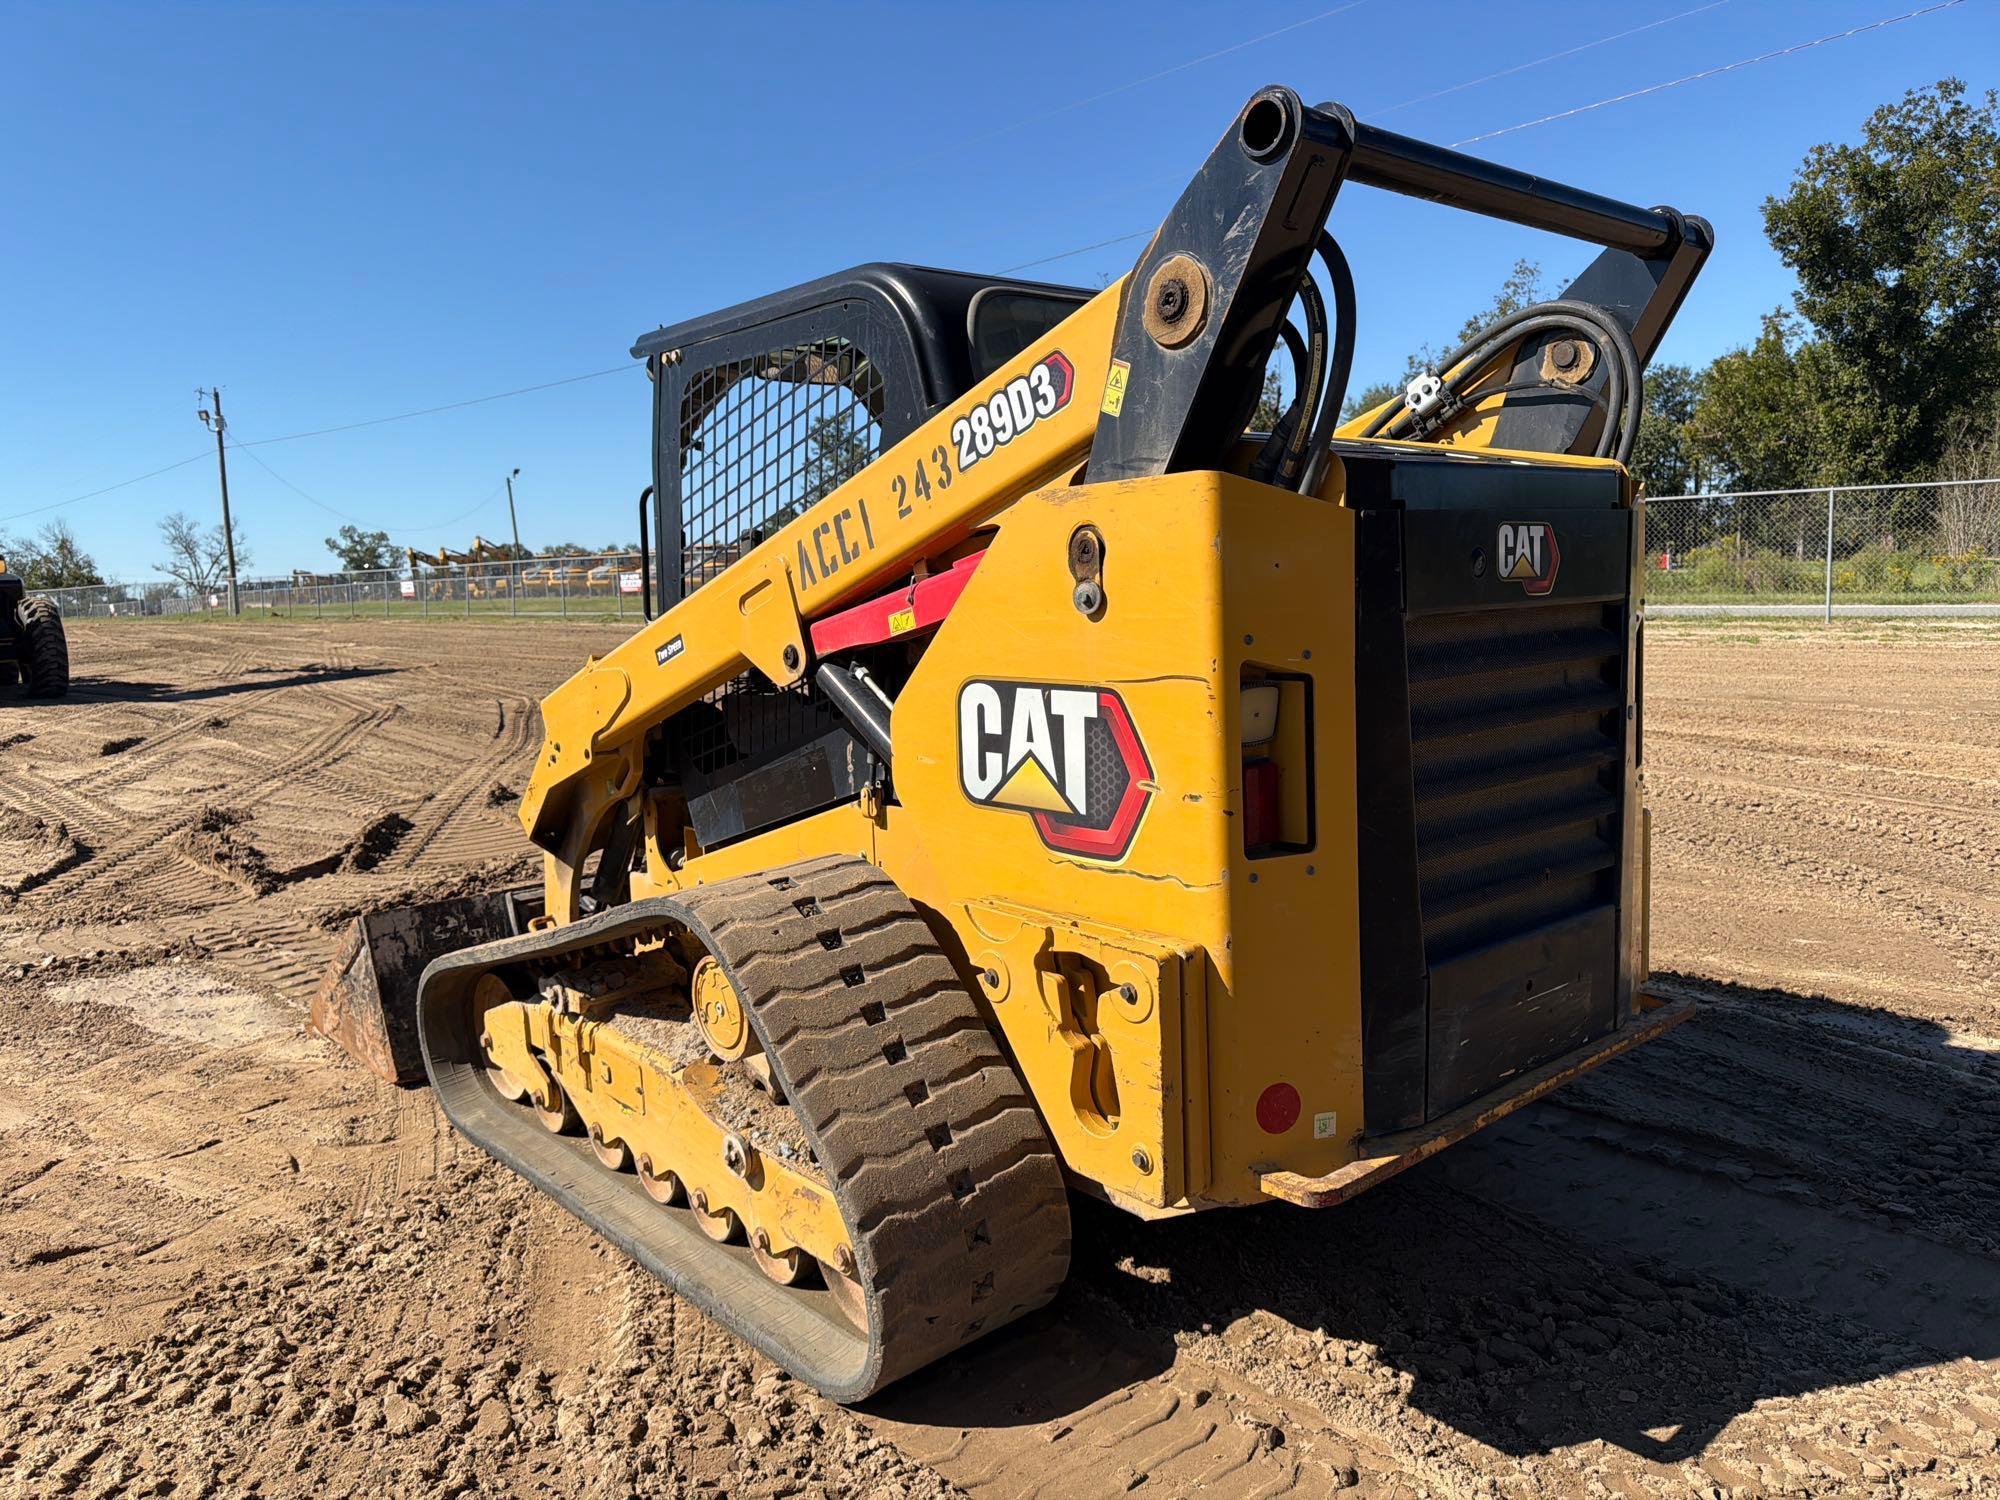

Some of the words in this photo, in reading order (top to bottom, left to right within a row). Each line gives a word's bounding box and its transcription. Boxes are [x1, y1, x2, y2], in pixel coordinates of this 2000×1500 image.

[952, 363, 1056, 470] 289D3
[892, 445, 953, 520] 243
[1498, 524, 1545, 578] CAT
[960, 682, 1098, 816] CAT
